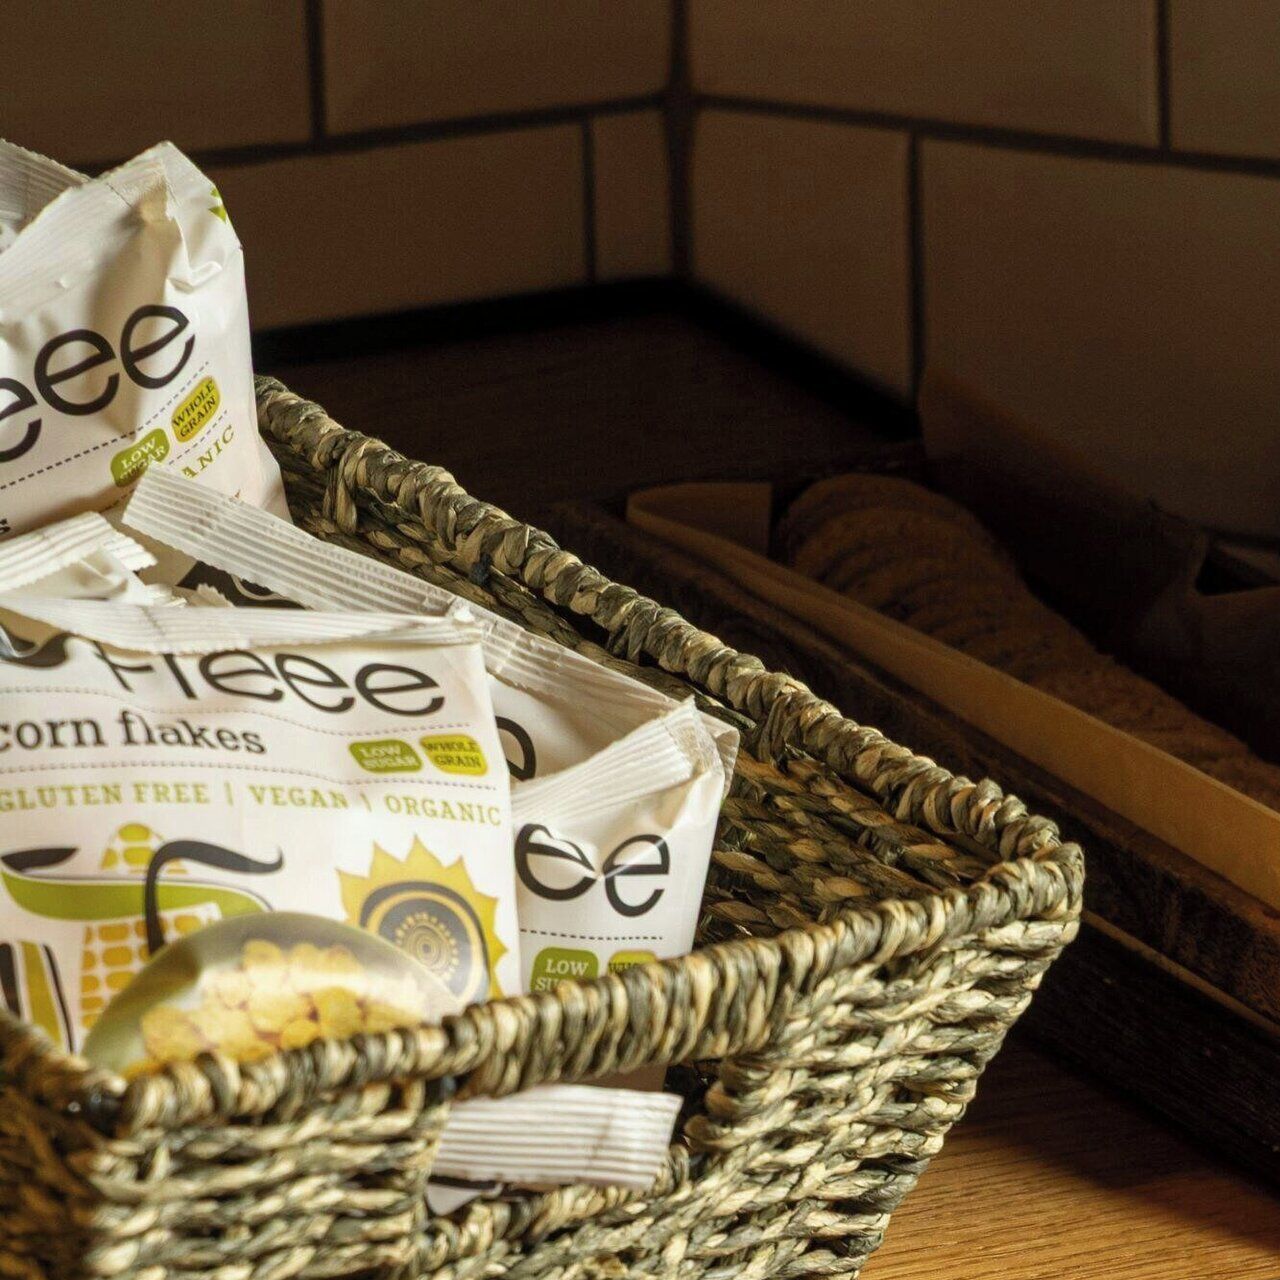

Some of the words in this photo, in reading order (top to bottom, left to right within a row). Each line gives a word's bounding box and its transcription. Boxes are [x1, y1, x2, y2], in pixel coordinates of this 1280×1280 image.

[172, 378, 216, 427] WHOLE
[180, 397, 217, 437] GRAIN
[121, 438, 157, 469] LOW
[119, 709, 268, 755] flakes
[434, 754, 482, 768] GRAIN
[0, 783, 123, 813] GLUTEN
[132, 782, 210, 805] FREE
[249, 785, 351, 810] VEGAN
[384, 794, 502, 826] ORGANIC
[545, 958, 589, 976] LOW
